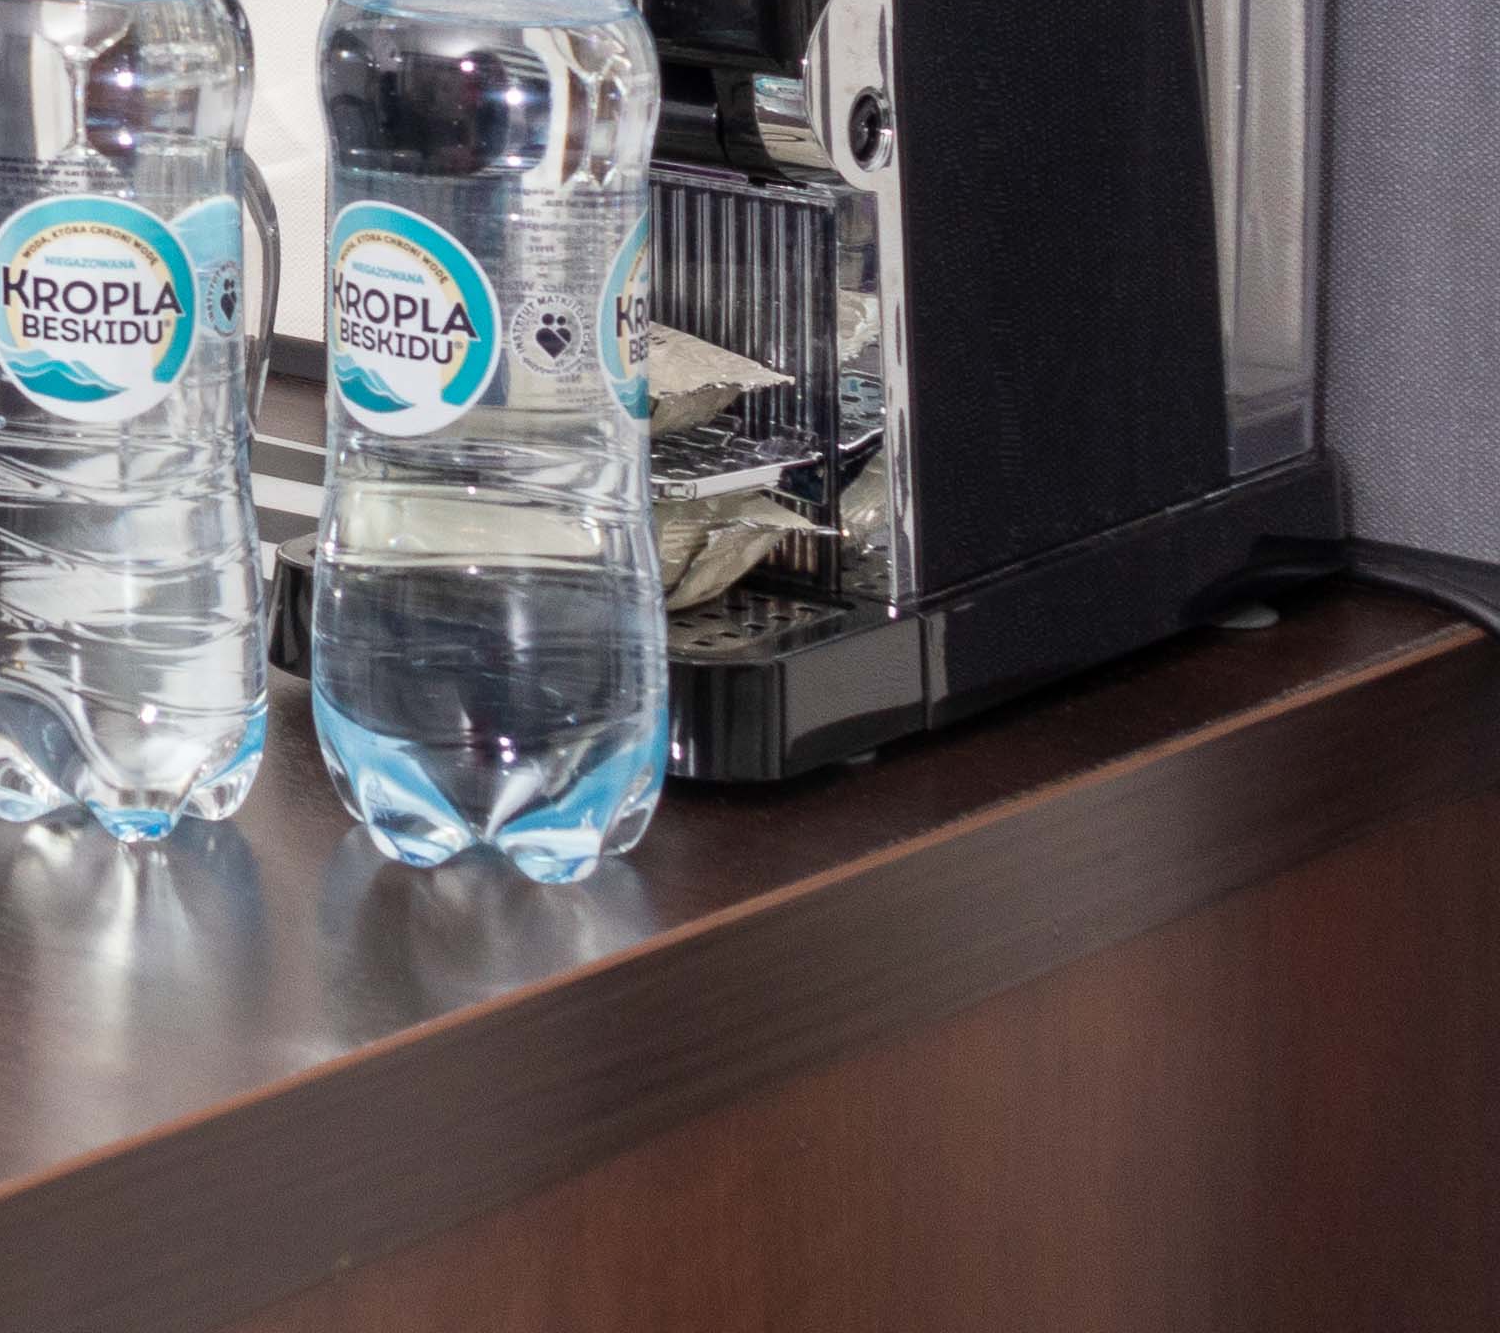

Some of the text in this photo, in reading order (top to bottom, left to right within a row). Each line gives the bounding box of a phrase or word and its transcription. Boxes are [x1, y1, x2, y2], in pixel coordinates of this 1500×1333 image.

[90, 226, 132, 245] CHRONI
[383, 235, 422, 258] CHRONI
[44, 255, 137, 270] NIEGAZOWANA
[2, 266, 183, 317] KROPLA
[332, 268, 478, 339] KROPLA
[21, 313, 164, 346] BESKIDU
[340, 317, 454, 365] BESKIDU
